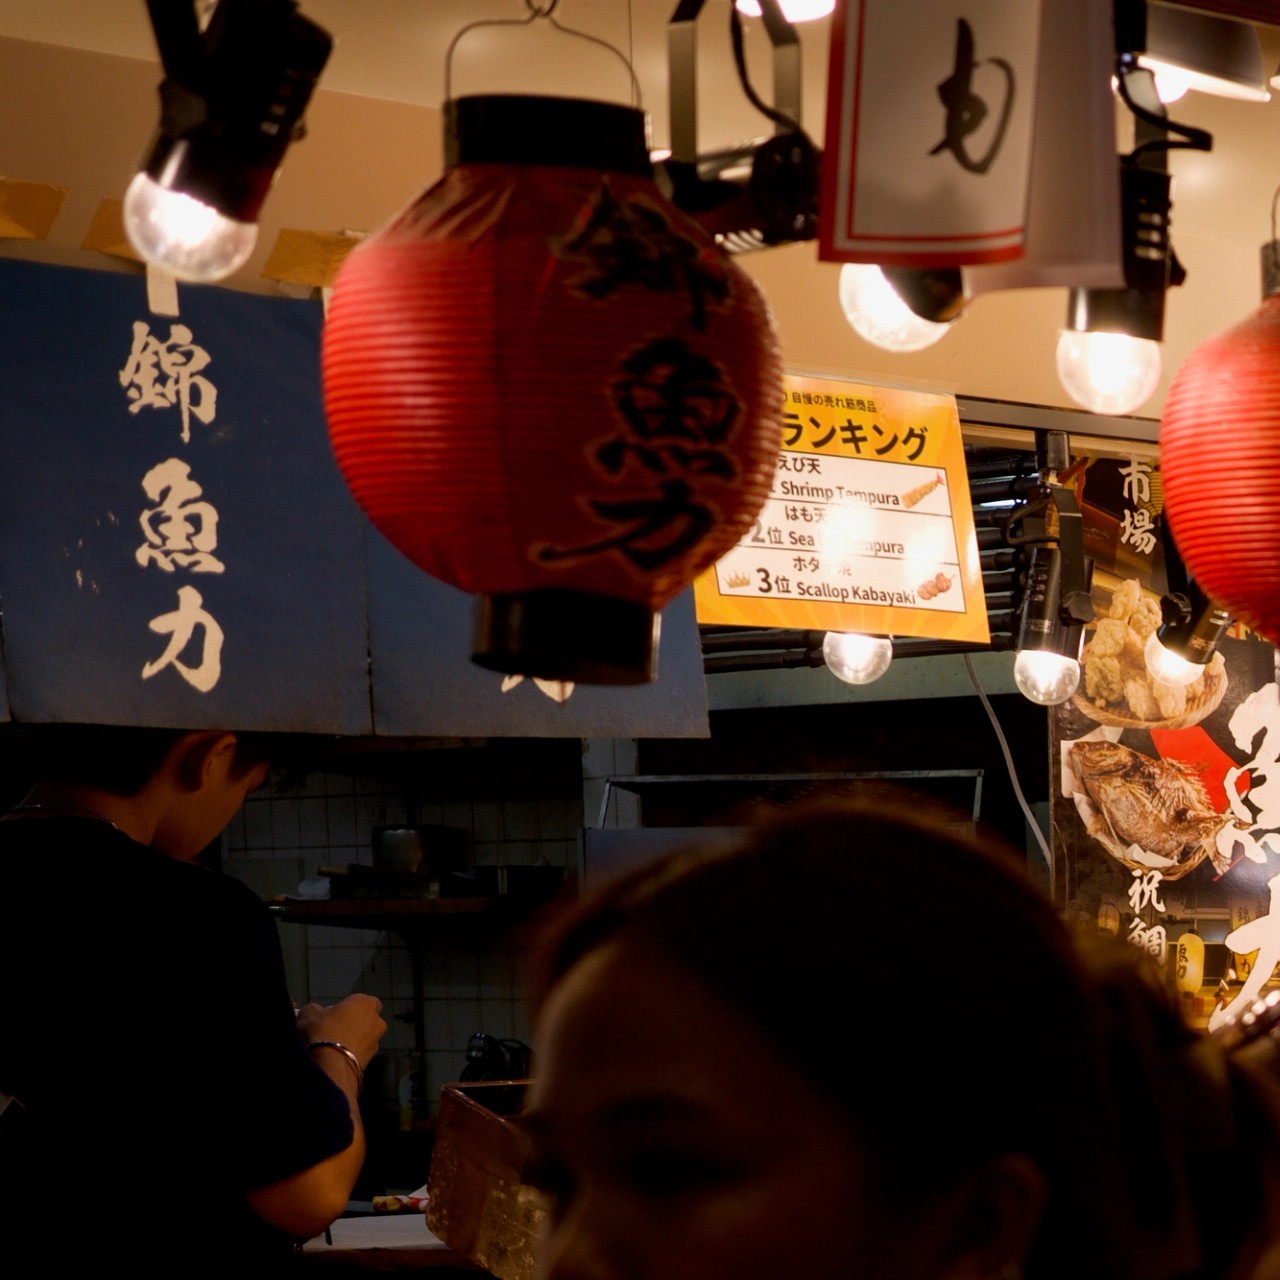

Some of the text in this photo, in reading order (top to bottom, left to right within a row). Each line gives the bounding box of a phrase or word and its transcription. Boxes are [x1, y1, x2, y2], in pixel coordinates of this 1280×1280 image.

[781, 481, 834, 502] Shrimp
[119, 320, 226, 694] 錦魚力
[1118, 454, 1158, 556] 市場
[789, 530, 815, 547] Sea
[796, 581, 849, 602] Scallop
[852, 586, 917, 607] Kabayaki
